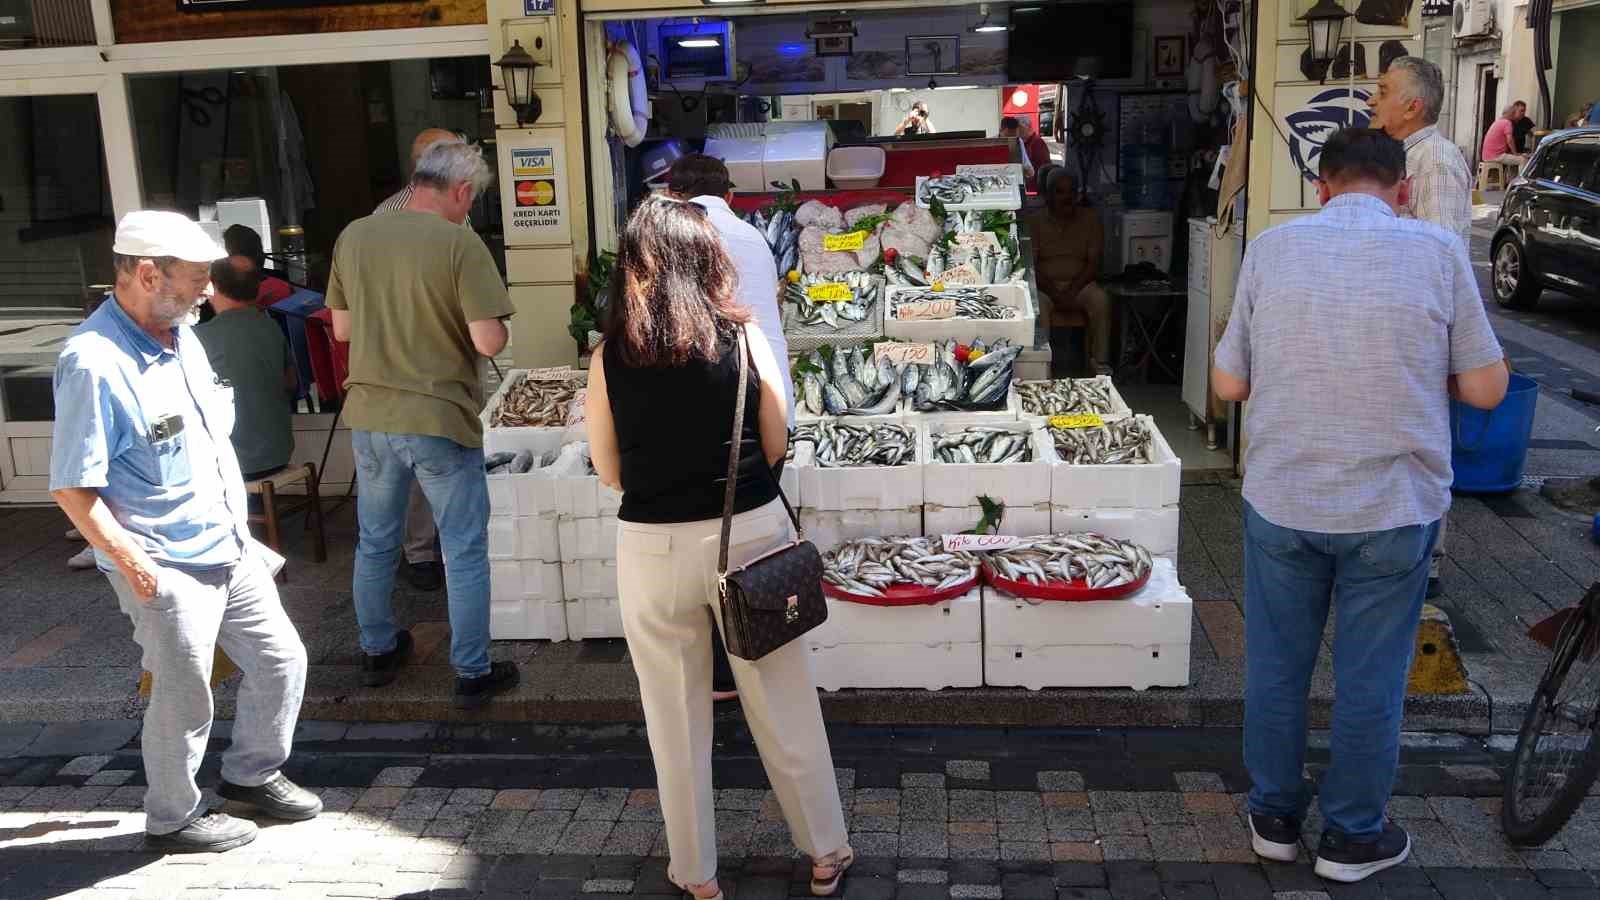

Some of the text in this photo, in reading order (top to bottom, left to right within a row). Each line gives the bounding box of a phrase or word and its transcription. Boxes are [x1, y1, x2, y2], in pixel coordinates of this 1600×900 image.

[521, 157, 545, 167] VISA
[513, 207, 560, 218] KREDİ KARTI
